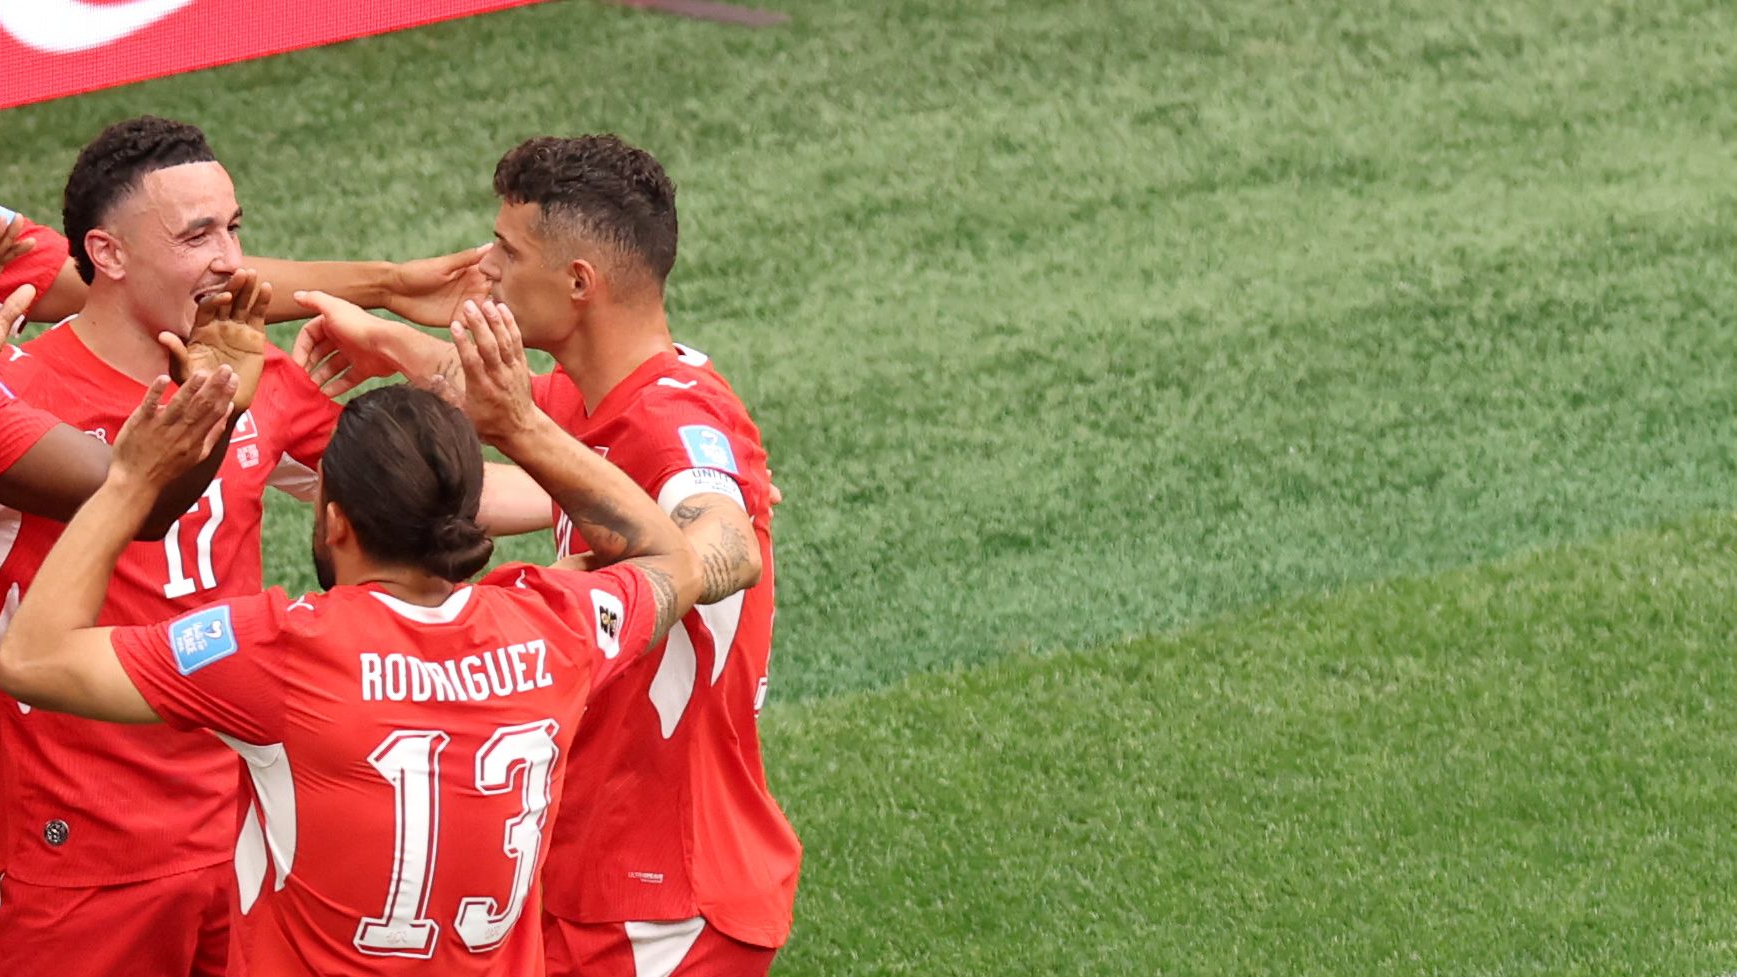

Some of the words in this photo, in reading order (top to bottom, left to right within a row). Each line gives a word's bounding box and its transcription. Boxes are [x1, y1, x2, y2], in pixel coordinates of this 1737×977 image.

[163, 477, 225, 599] 17
[360, 639, 553, 702] RODRIGUEZ
[353, 719, 560, 959] 13
